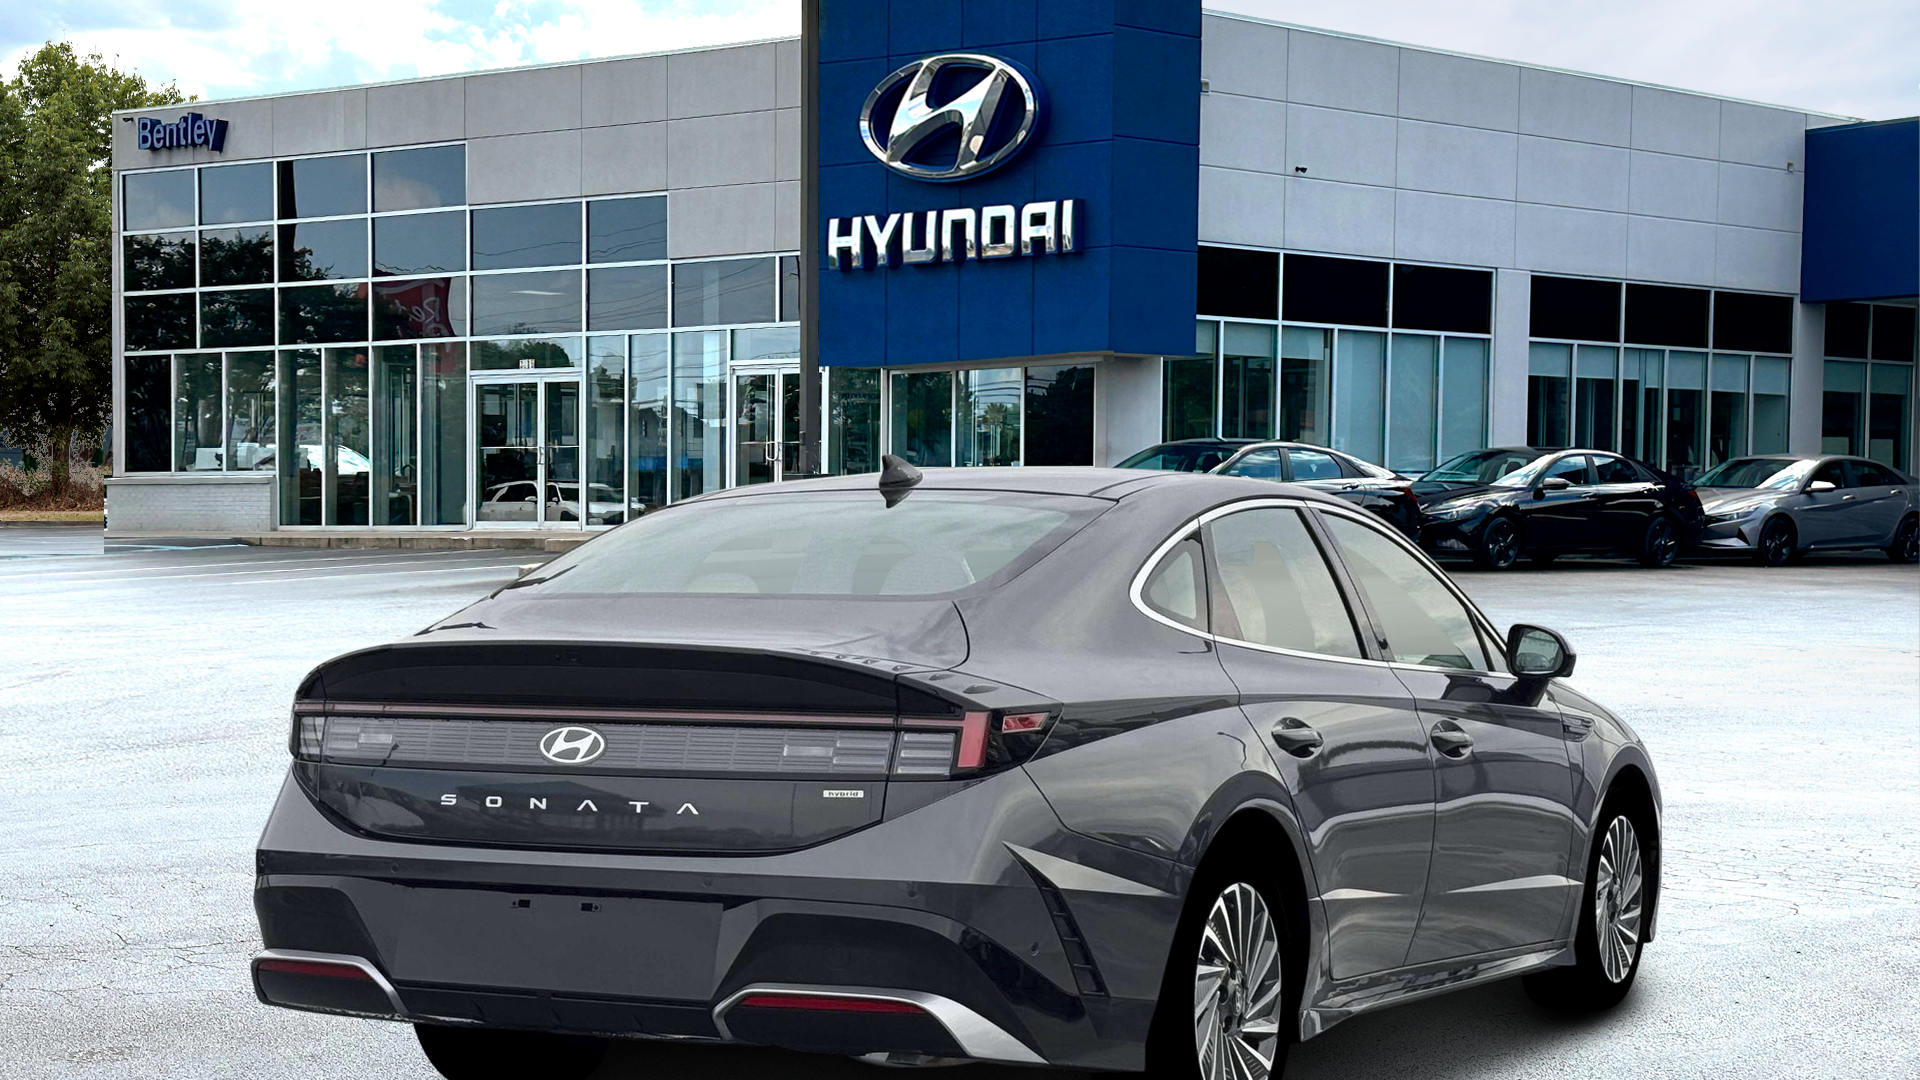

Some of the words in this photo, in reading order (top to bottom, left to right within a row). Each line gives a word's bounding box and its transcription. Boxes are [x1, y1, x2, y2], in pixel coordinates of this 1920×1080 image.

[138, 112, 220, 152] Bentley
[827, 199, 1075, 270] HYUNDAI
[438, 793, 700, 815] SONATA
[827, 790, 860, 798] hybrid
